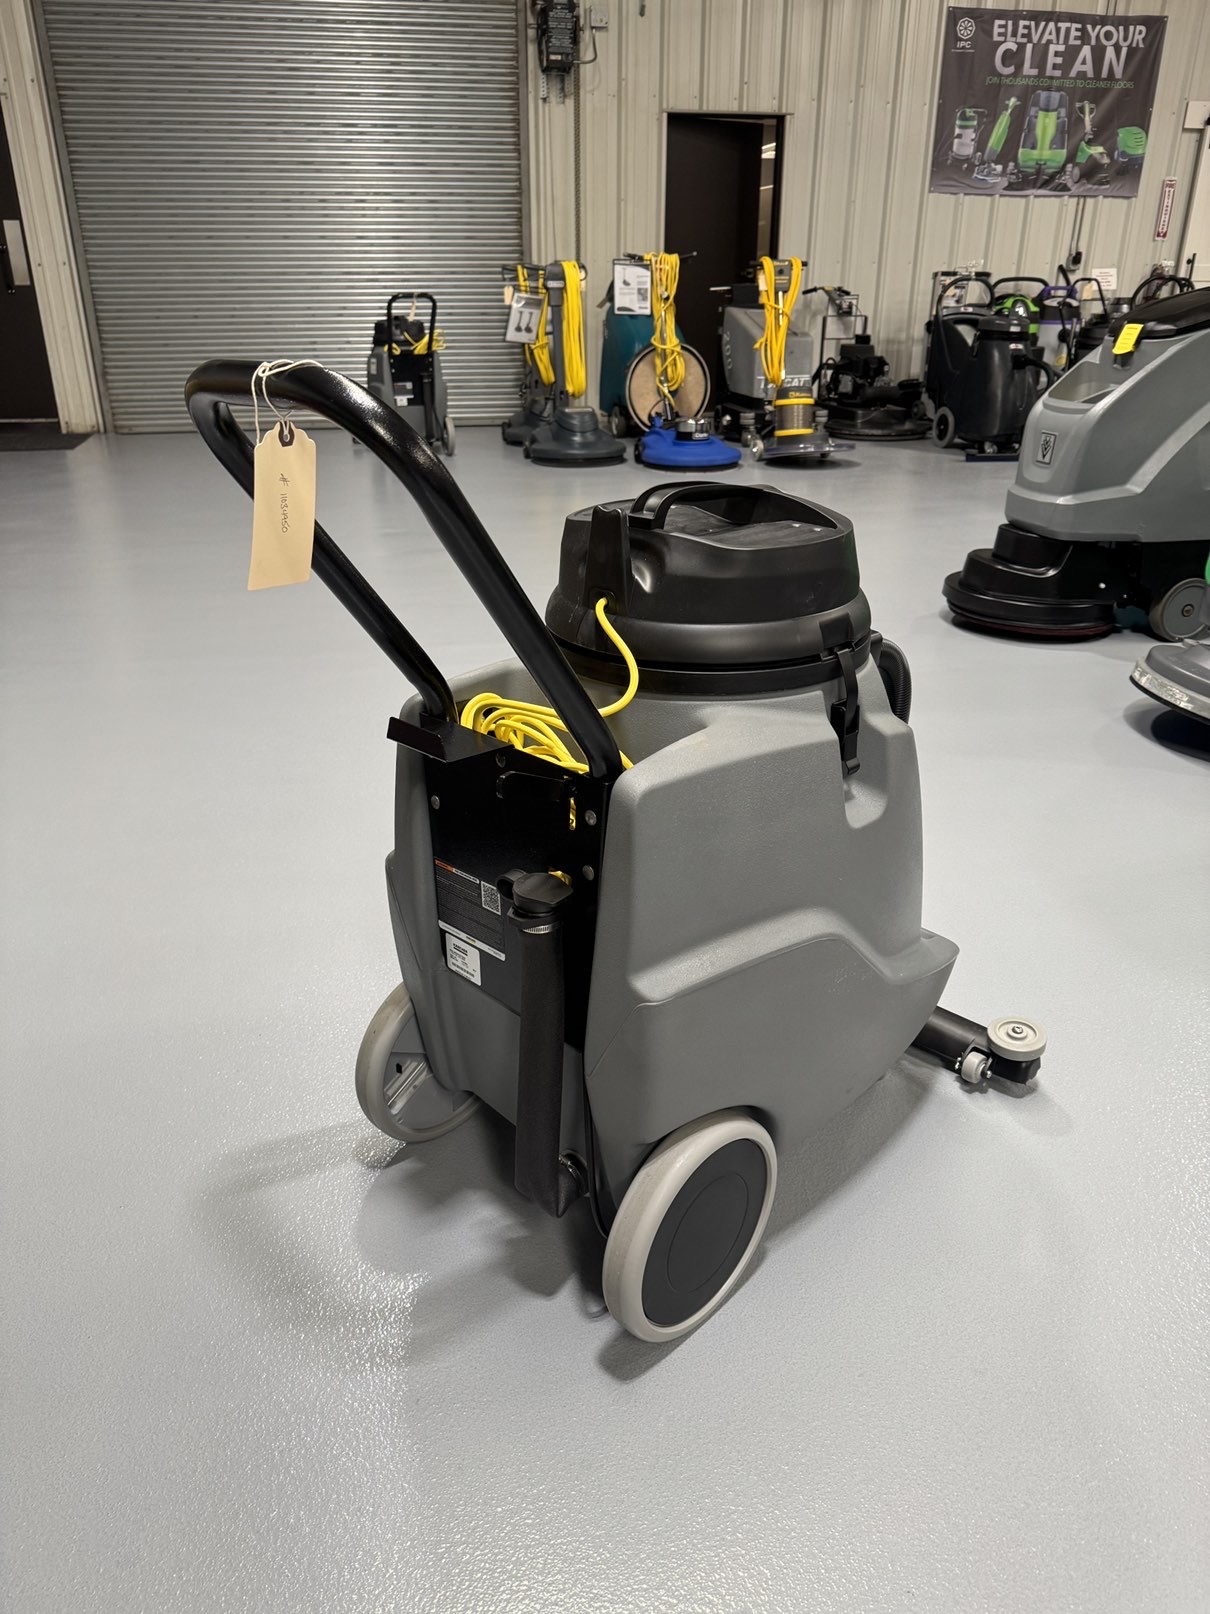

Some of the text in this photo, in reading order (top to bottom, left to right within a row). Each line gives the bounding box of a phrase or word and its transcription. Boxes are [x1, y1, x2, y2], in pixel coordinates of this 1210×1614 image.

[992, 19, 1147, 48] ELEVATE YOUR
[956, 41, 972, 49] IPC
[994, 41, 1129, 79] CLEAN
[1000, 76, 1039, 87] THOUSANDS
[1076, 79, 1085, 88] TO
[756, 376, 810, 389] TCAT
